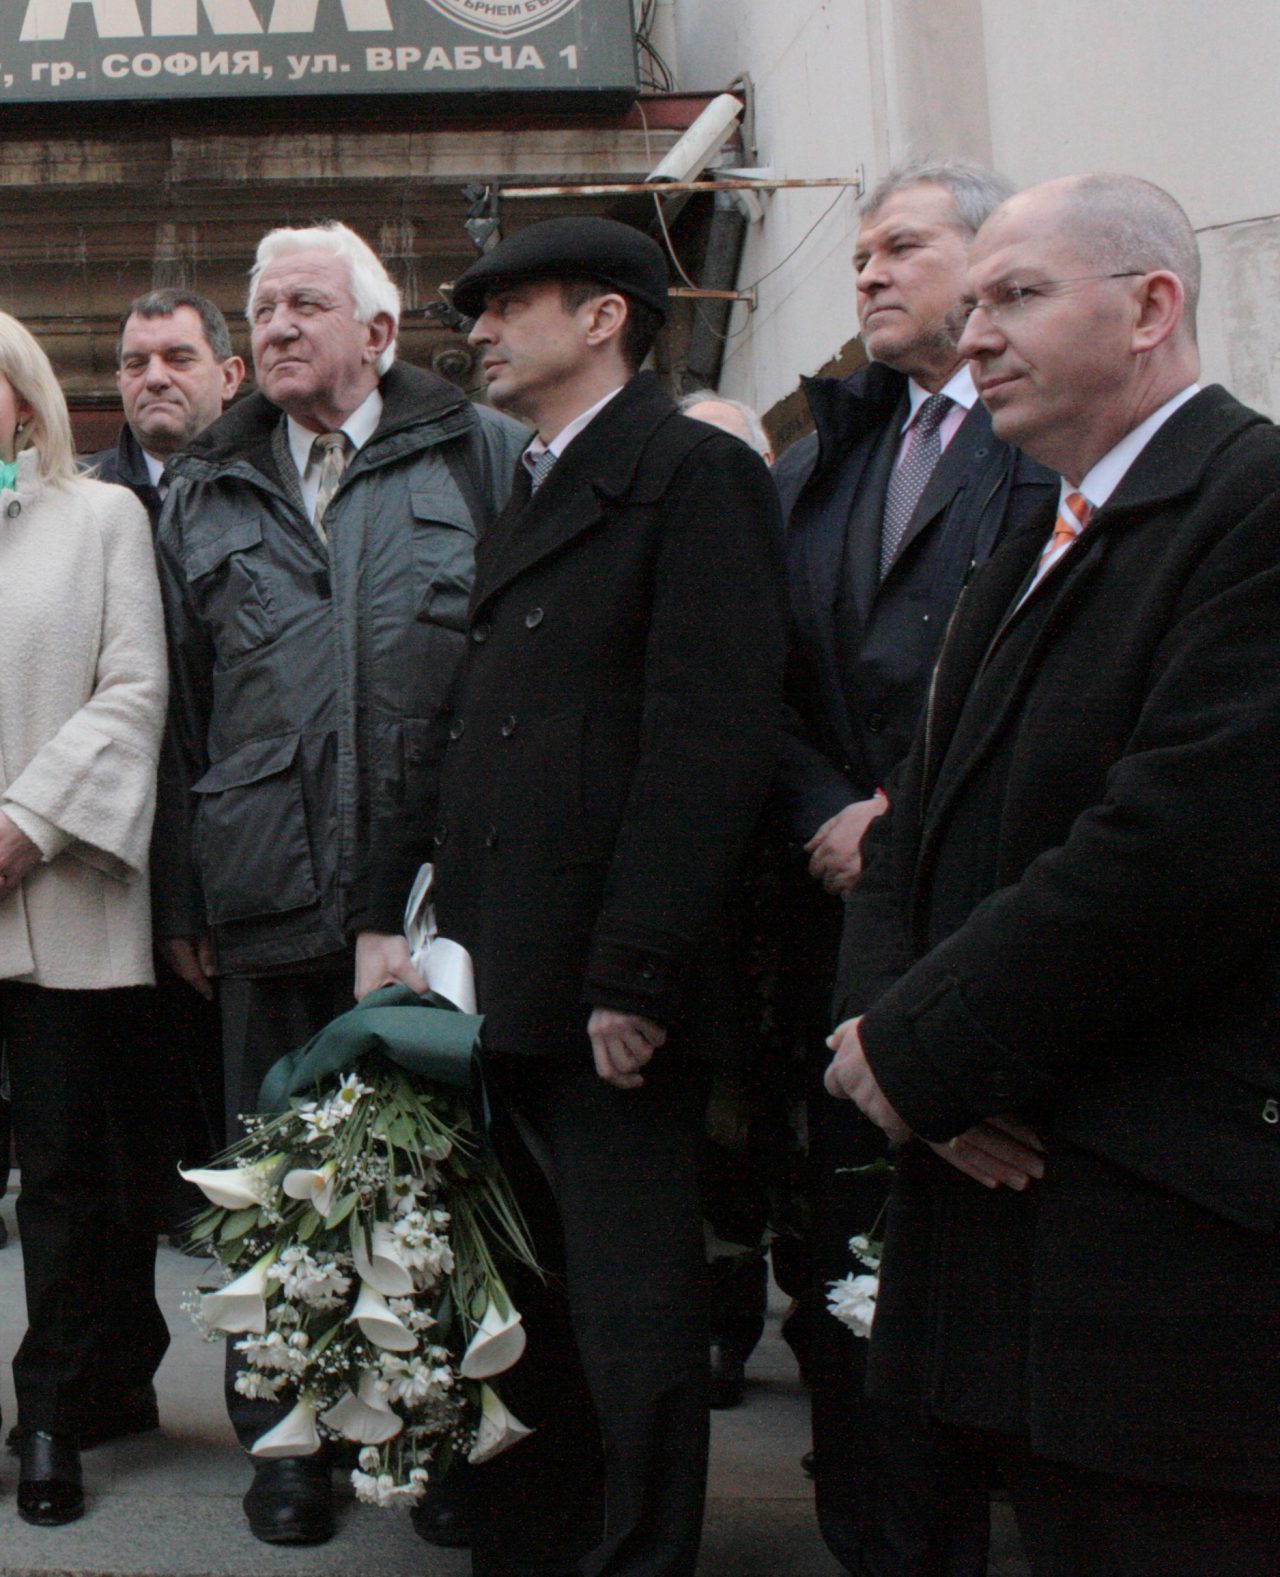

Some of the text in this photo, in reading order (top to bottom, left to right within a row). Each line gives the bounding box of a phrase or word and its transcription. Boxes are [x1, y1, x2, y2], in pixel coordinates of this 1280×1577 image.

[456, 0, 521, 16] ЪРНЕМ
[31, 61, 86, 87] гр.
[101, 50, 273, 80] СОФИЯ,
[286, 54, 350, 80] ул.
[365, 45, 545, 72] ВРАБЧА
[558, 45, 577, 69] 1
